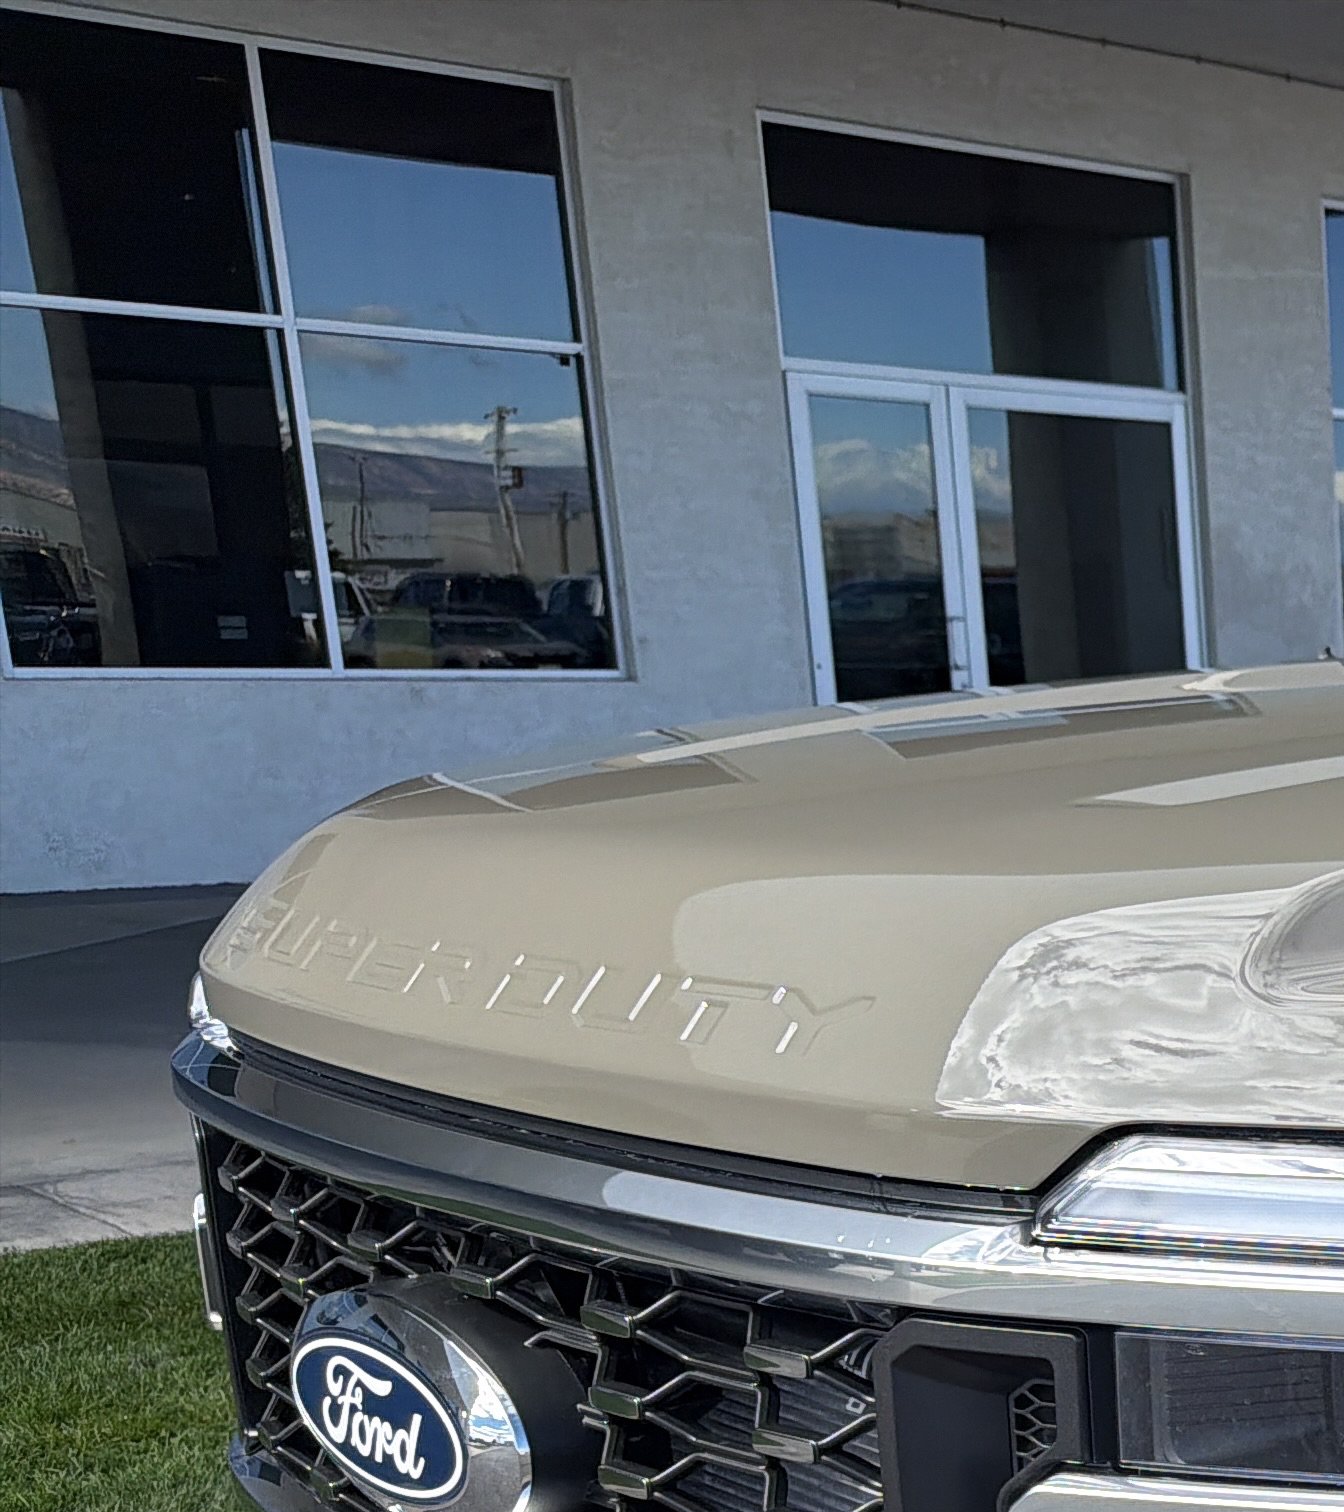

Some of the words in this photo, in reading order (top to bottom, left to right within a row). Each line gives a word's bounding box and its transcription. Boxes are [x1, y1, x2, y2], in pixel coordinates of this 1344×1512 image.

[222, 905, 474, 1005] SUPER
[483, 952, 877, 1057] DUTY
[321, 1354, 426, 1480] Ford
